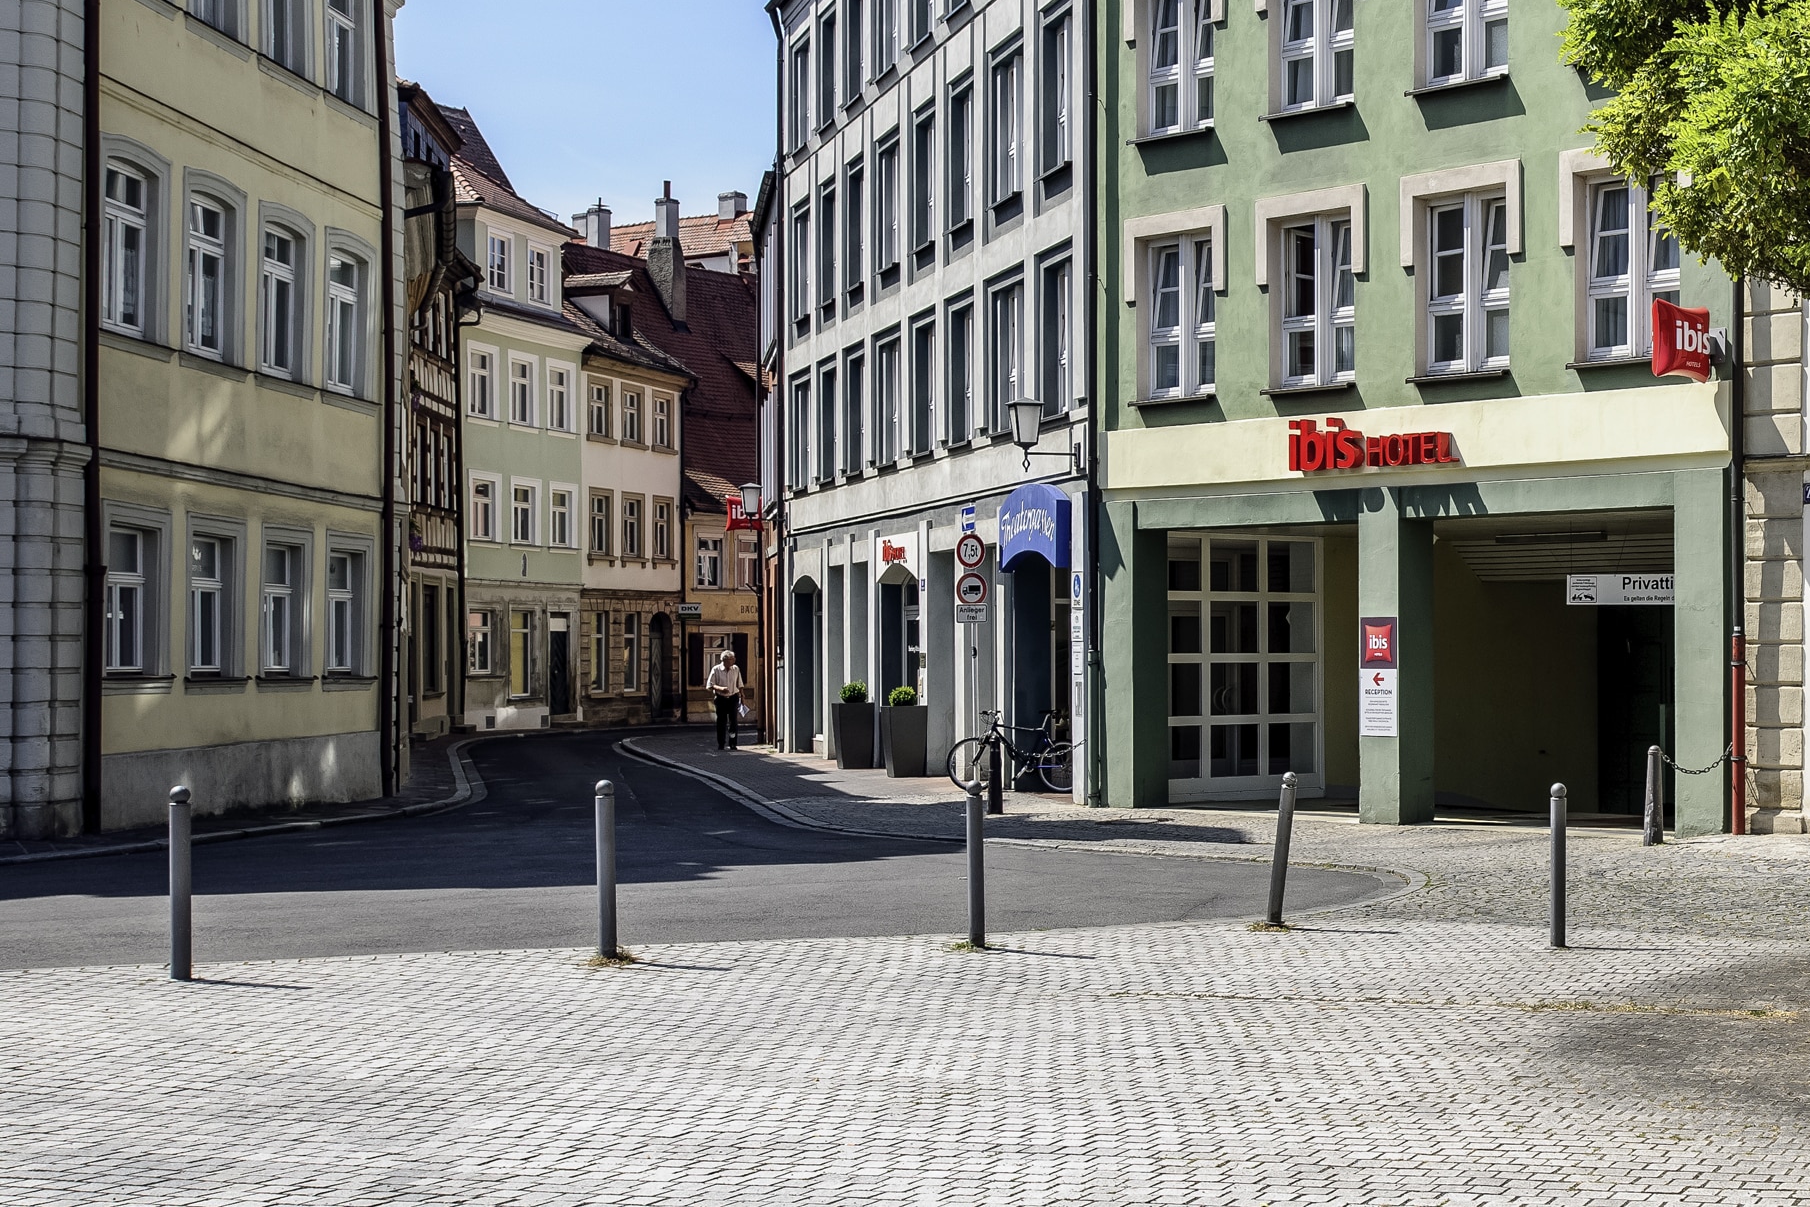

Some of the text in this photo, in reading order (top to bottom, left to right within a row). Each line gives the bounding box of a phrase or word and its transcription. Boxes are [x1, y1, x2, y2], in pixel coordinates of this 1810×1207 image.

[1675, 319, 1711, 355] ibis
[1289, 417, 1460, 472] ibis HOTEL
[731, 504, 760, 520] ibs
[963, 542, 979, 561] 7,5t
[959, 606, 985, 614] Anlieger
[1369, 634, 1388, 650] ibis
